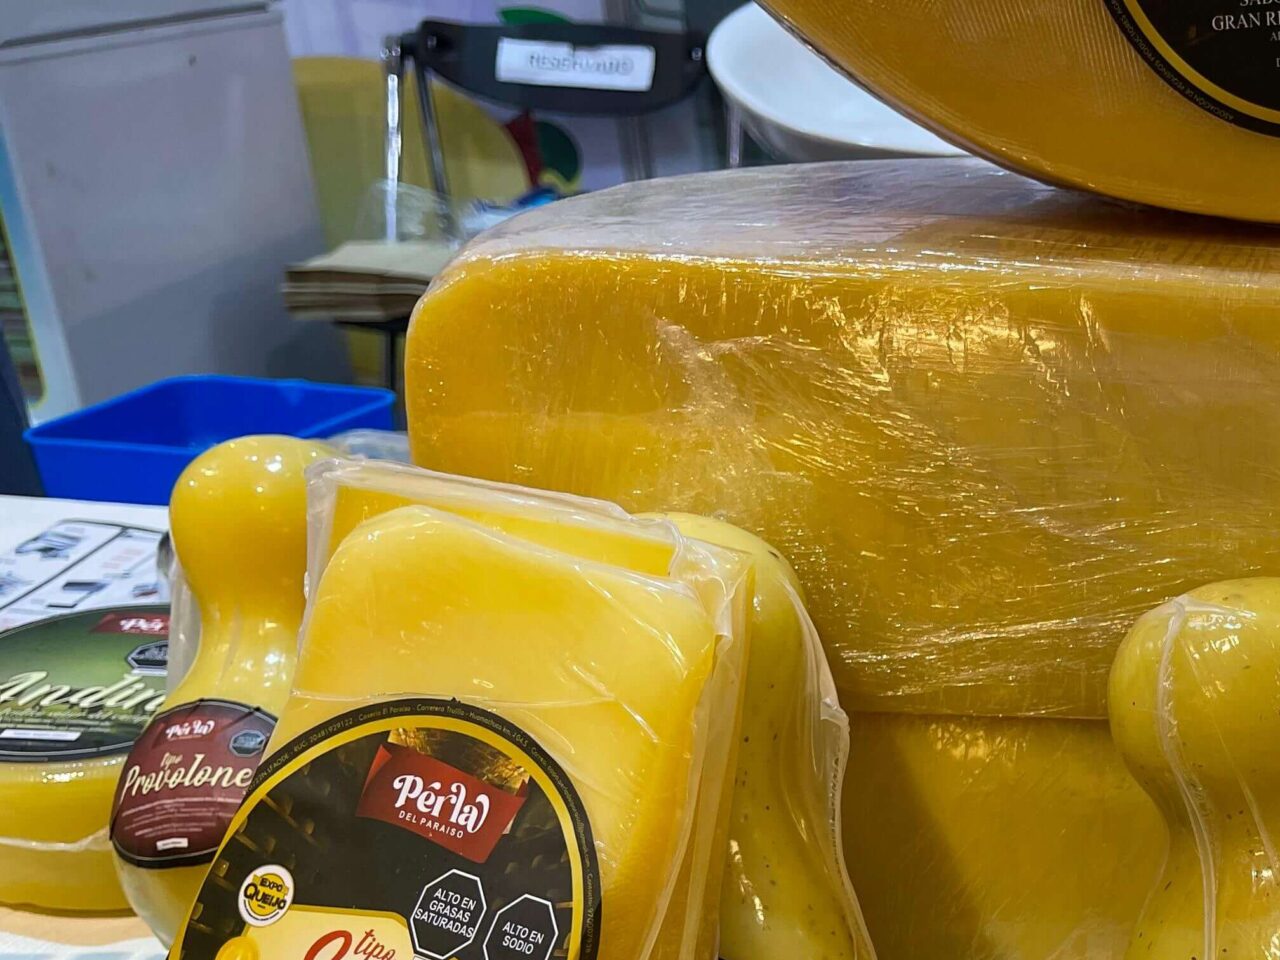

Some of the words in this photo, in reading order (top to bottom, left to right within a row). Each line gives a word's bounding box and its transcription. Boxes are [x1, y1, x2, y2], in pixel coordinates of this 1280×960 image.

[1212, 15, 1262, 31] GRAN
[0, 671, 167, 711] Andin
[120, 753, 253, 804] Provolone
[398, 810, 417, 823] DEL
[420, 818, 464, 838] PARAISO
[244, 883, 287, 909] QUEIJO
[260, 878, 282, 892] EXPO
[429, 900, 470, 922] GRASAS
[434, 888, 460, 904] ALTO
[462, 897, 476, 911] EN
[415, 908, 474, 938] SATURADAS
[502, 922, 528, 938] ALTO
[529, 931, 544, 944] EN
[503, 936, 533, 954] SODIO
